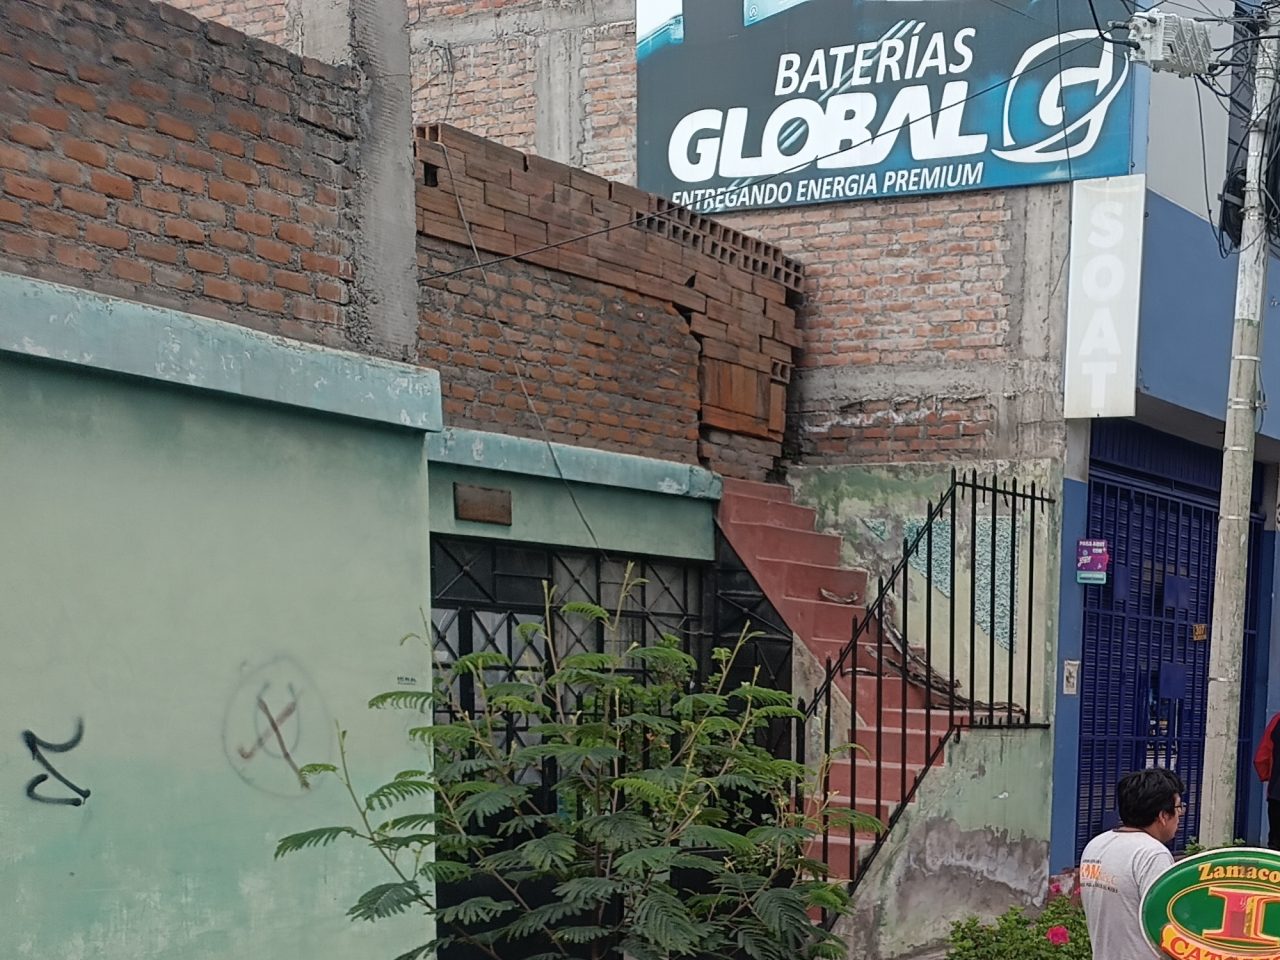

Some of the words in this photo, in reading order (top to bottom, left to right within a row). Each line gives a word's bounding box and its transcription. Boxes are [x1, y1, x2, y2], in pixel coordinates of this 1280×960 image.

[774, 22, 977, 96] BATERÍAS
[667, 80, 990, 182] GLOBAL
[671, 181, 793, 210] ENTREGANDO
[796, 166, 878, 202] ENERGIA
[882, 162, 984, 194] PREMIUM
[1079, 201, 1125, 411] SOAT
